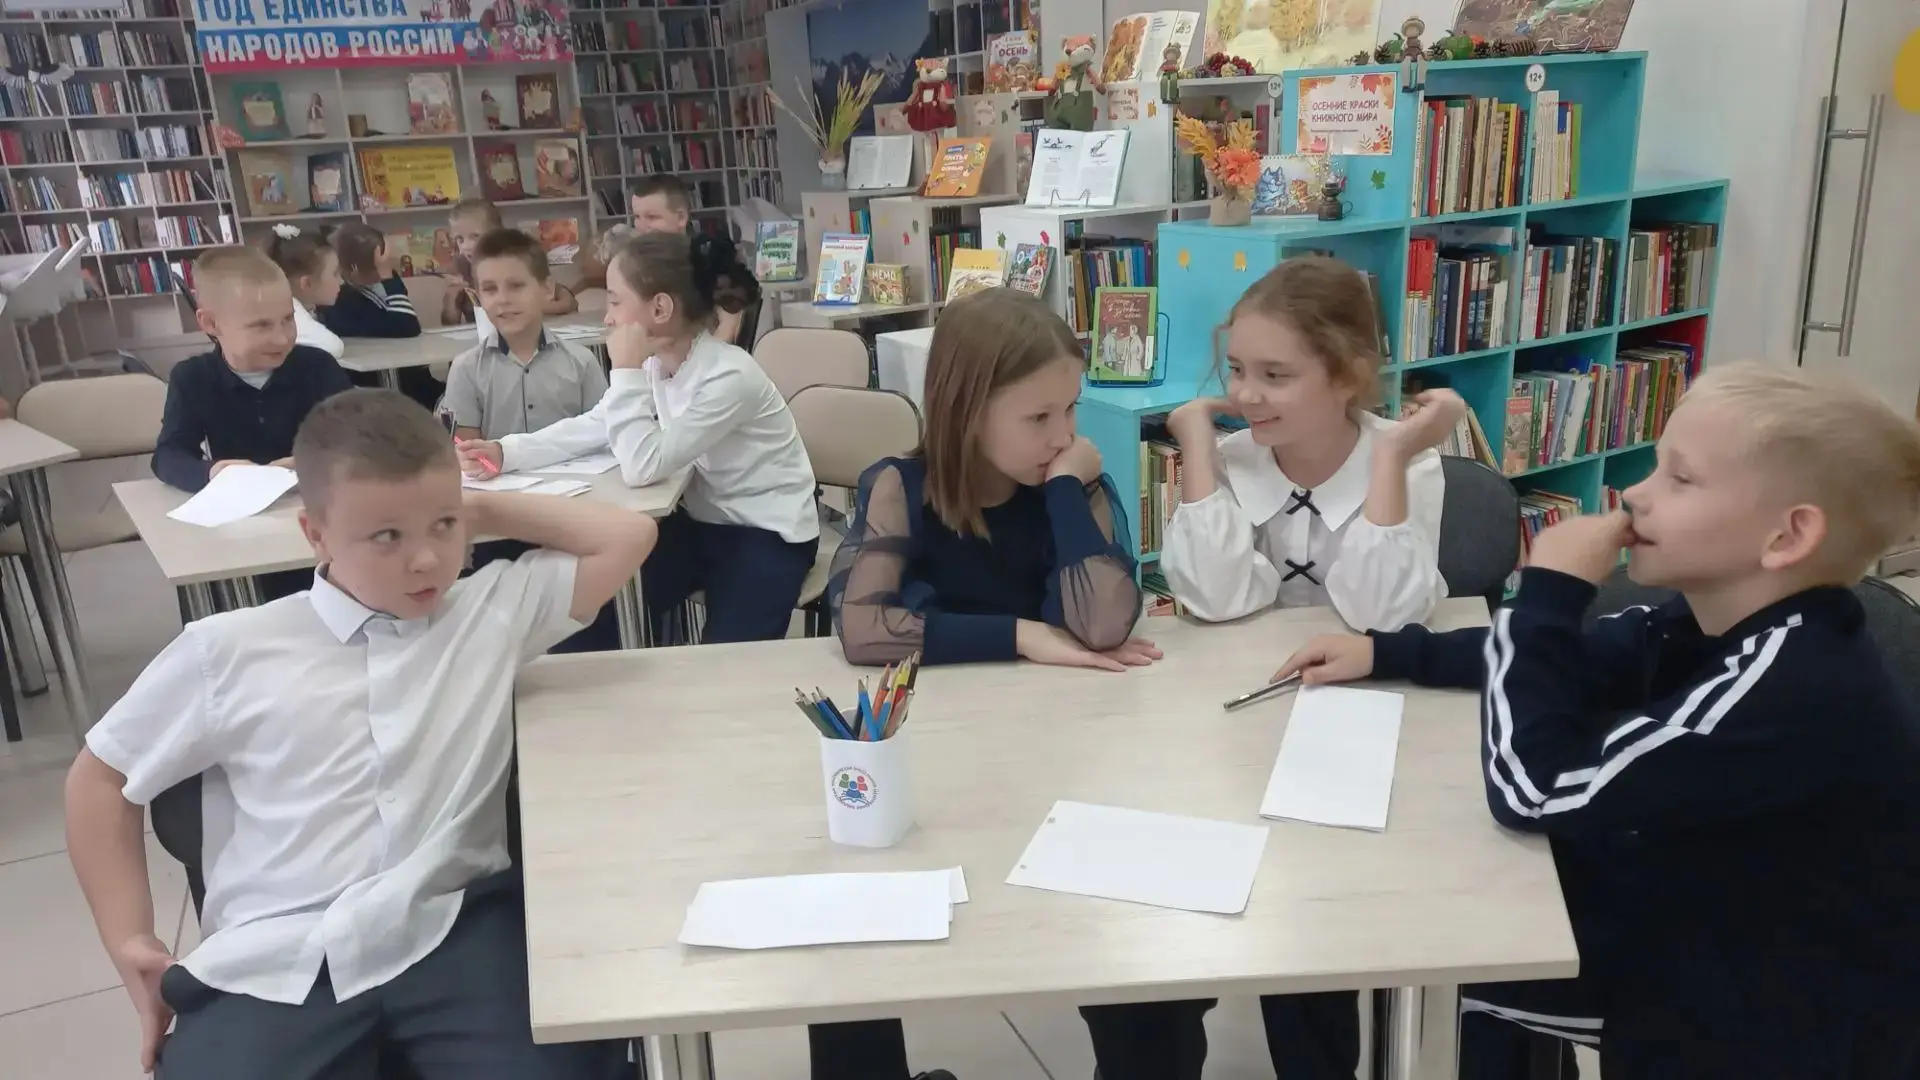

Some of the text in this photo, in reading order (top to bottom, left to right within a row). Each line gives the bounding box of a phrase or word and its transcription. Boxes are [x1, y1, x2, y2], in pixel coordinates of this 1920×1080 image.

[197, 0, 408, 25] ГОД ЕДИНСТВА
[204, 28, 456, 64] НАРОДОВ РОССИИ
[999, 46, 1029, 57] ОСЕНЬ
[1529, 72, 1543, 82] 12+
[1312, 99, 1380, 111] ОСЕННИЕ КРАСКИ
[1311, 112, 1379, 123] КНИЖНОГО МИРА
[872, 268, 897, 281] МЕМО
